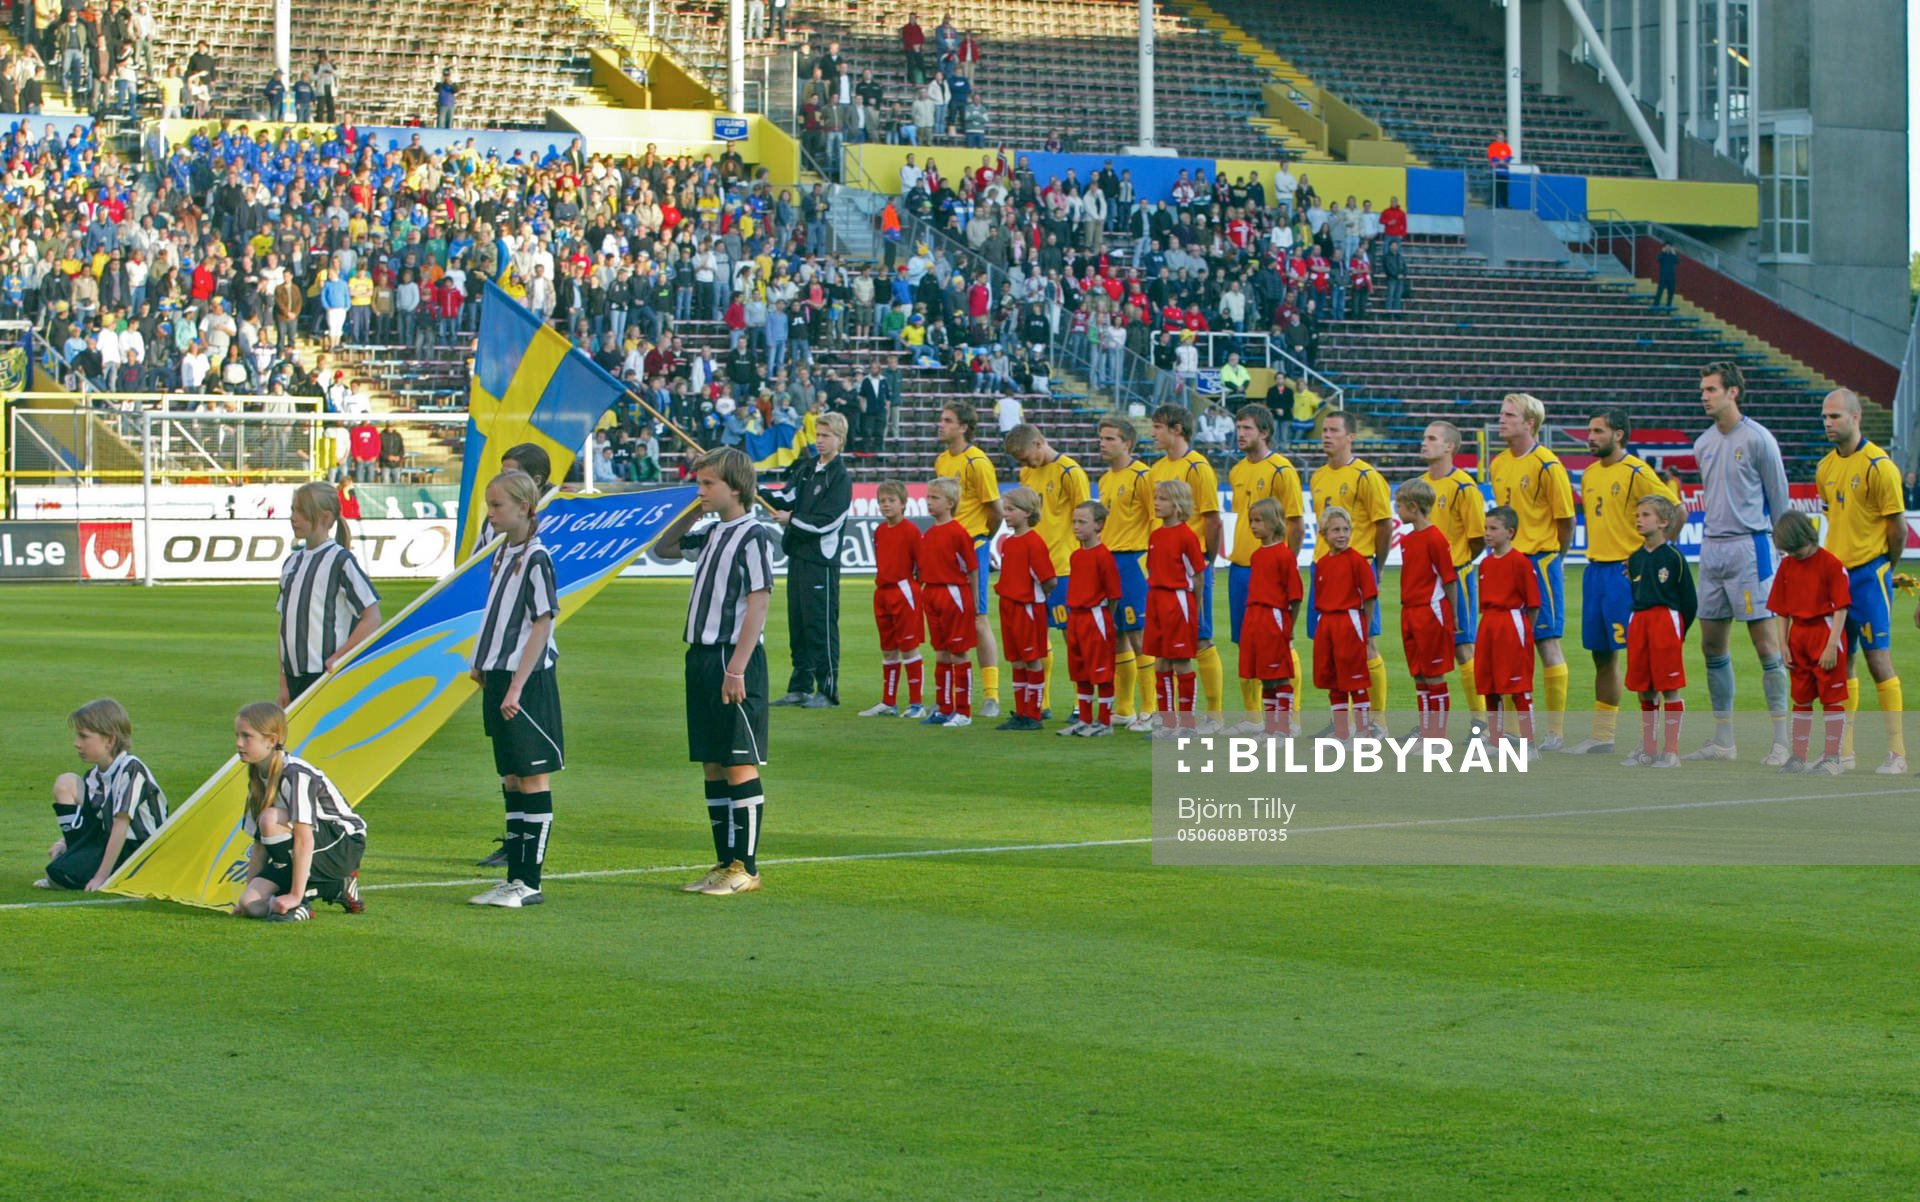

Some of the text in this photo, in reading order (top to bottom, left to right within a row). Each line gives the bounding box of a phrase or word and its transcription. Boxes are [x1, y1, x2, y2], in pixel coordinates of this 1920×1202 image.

[569, 507, 643, 532] GAME
[635, 500, 673, 526] IS
[1595, 496, 1603, 517] 2
[0, 533, 66, 567] l.se
[162, 535, 397, 563] ODDT
[559, 537, 638, 562] PLAY
[1053, 605, 1068, 624] 10
[1743, 591, 1753, 615] 1
[1612, 622, 1627, 644] 2
[1860, 622, 1873, 643] 4
